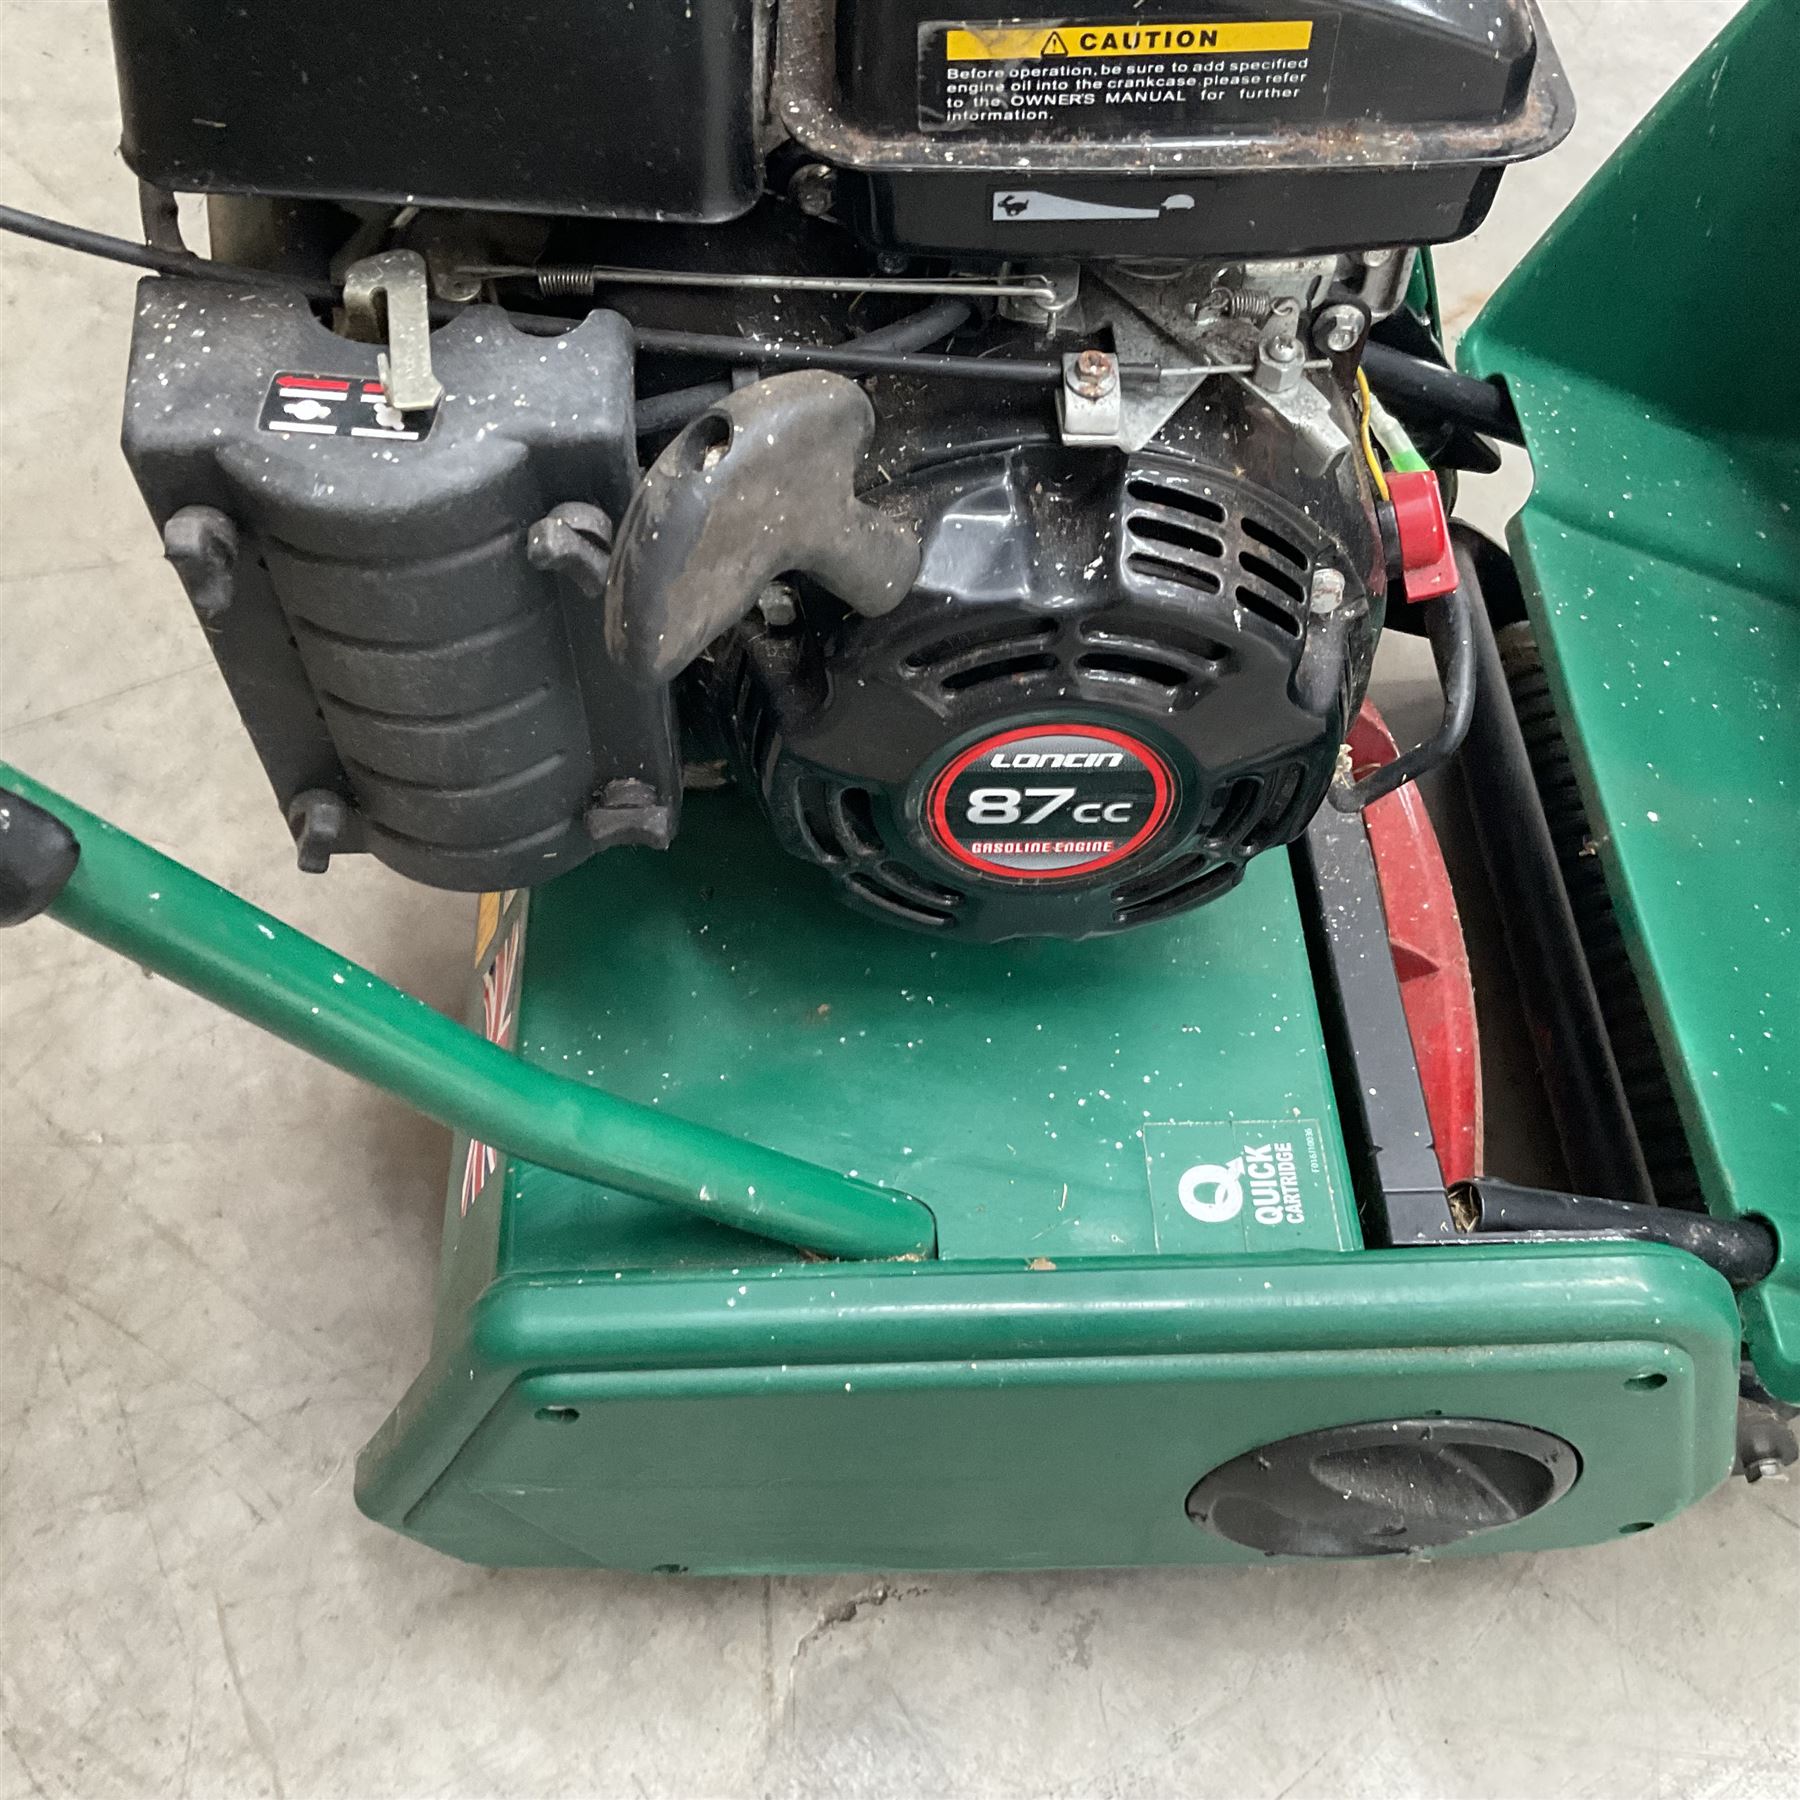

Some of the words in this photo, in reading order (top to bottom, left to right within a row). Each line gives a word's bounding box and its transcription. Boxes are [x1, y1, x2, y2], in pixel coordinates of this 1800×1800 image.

[1079, 30, 1218, 50] CAUTION
[946, 67, 1005, 80] Before
[1101, 63, 1122, 76] be
[1126, 62, 1165, 75] sure
[1172, 61, 1188, 73] to
[1193, 60, 1225, 72] add
[1229, 57, 1309, 73] specified
[946, 82, 1005, 95] engine
[1010, 80, 1031, 92] oil
[1036, 79, 1068, 91] into
[1075, 79, 1102, 91] the
[1203, 74, 1261, 88] please
[1265, 72, 1307, 84] refer
[946, 97, 964, 108] to
[973, 96, 1001, 108] the
[1010, 93, 1096, 106] OWNER'S
[1105, 89, 1186, 104] MANUAL
[1200, 88, 1225, 101] for
[1239, 87, 1300, 100] further
[946, 109, 1054, 122] information.
[1243, 1143, 1284, 1225] QUICK
[1273, 1142, 1305, 1224] CARTRIDGE
